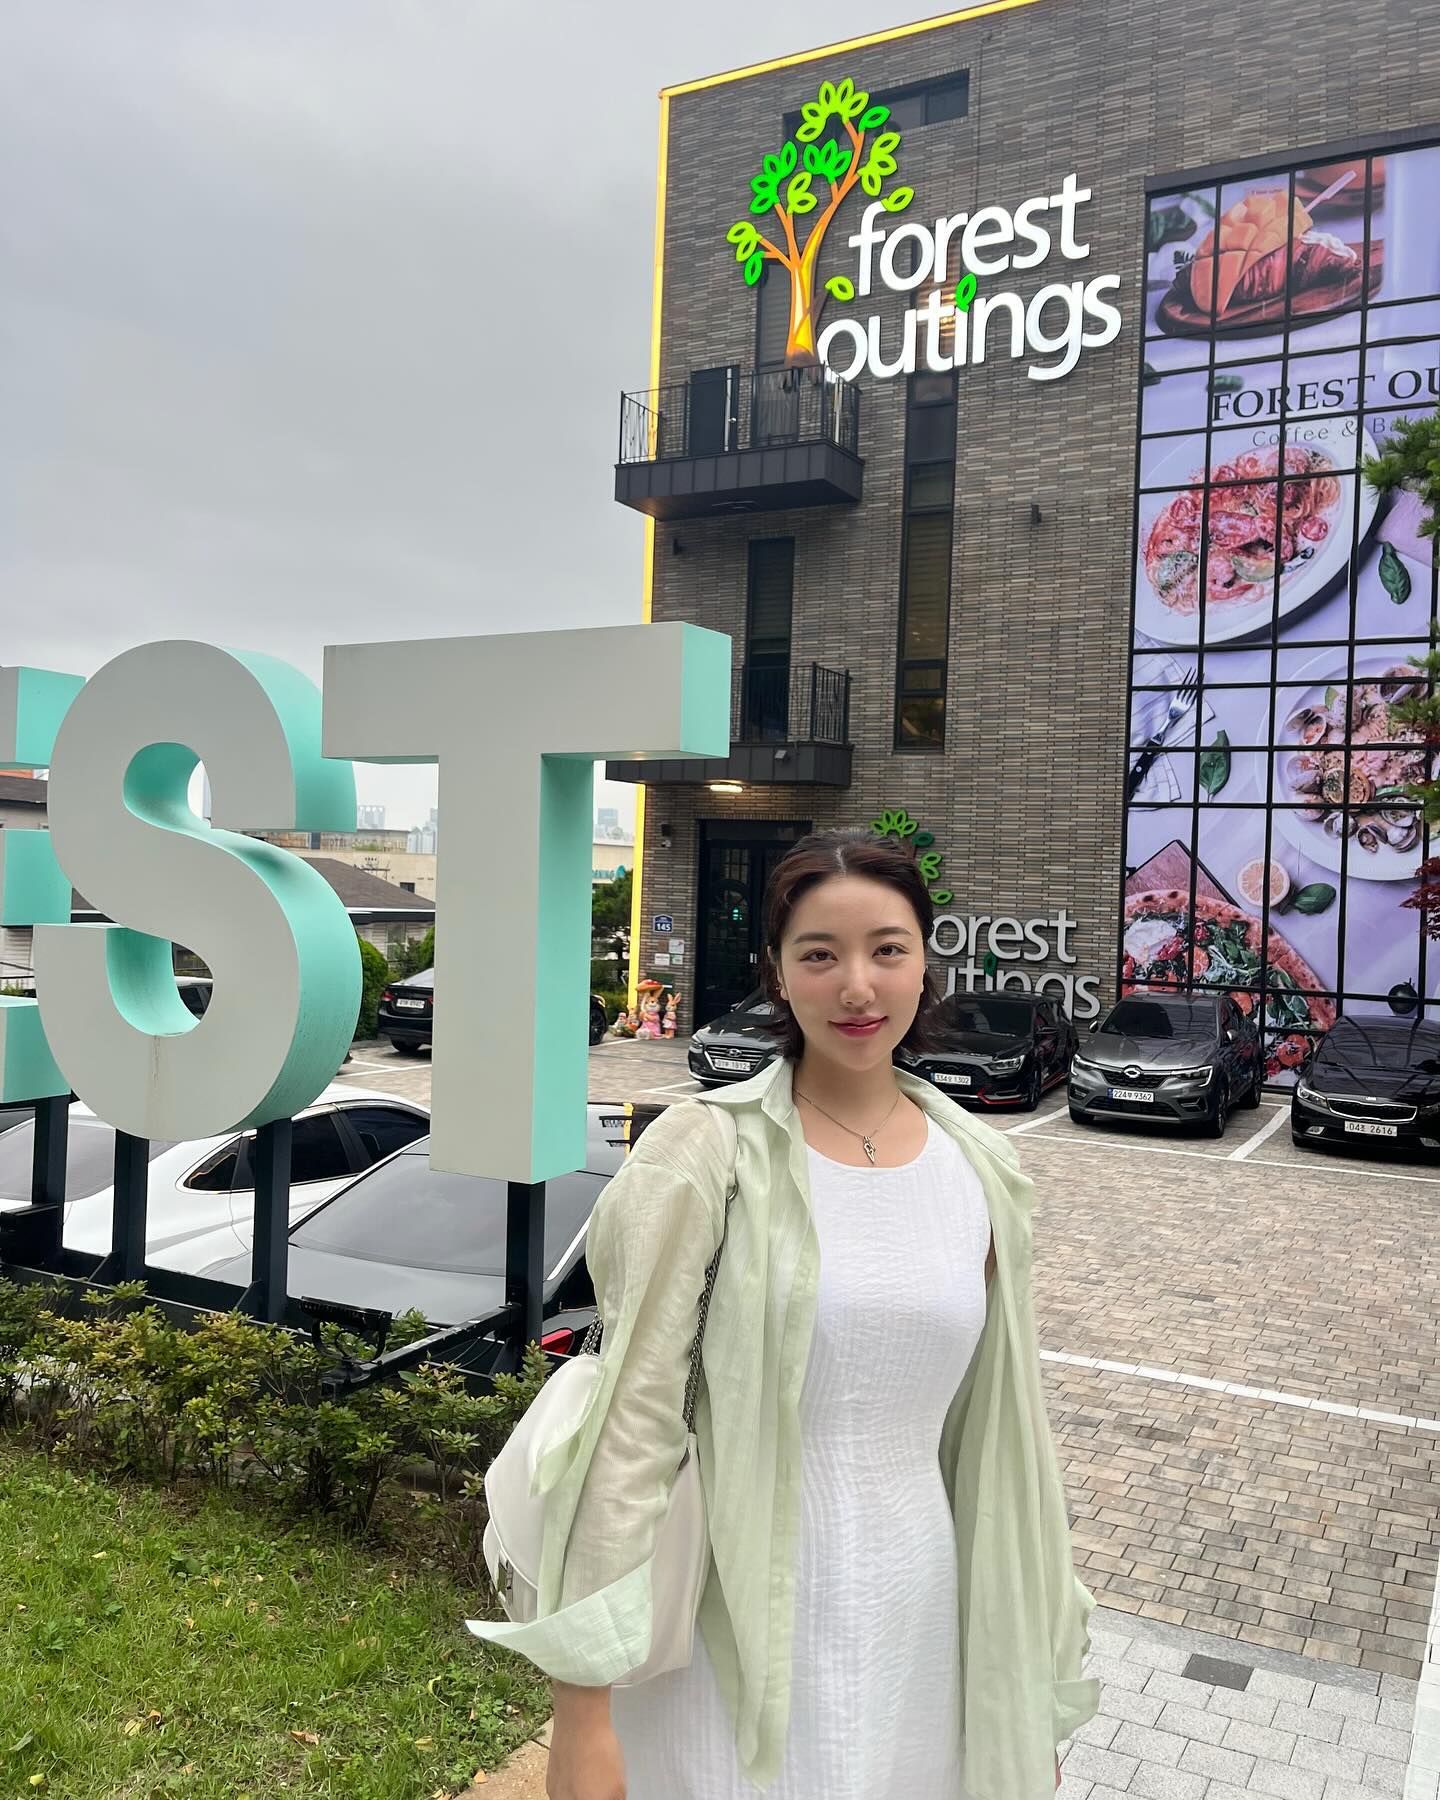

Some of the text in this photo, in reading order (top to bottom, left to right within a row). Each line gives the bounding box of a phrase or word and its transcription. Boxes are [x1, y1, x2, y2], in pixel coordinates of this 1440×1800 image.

[848, 172, 1092, 297] forest
[817, 274, 1122, 383] outings
[1212, 375, 1376, 421] FOREST
[1253, 426, 1329, 447] Coffee
[1342, 419, 1359, 438] &
[0, 622, 731, 1184] ST
[656, 923, 671, 931] 145
[928, 909, 1077, 964] orest
[942, 957, 1101, 1024] tins
[1370, 1125, 1393, 1135] 2616
